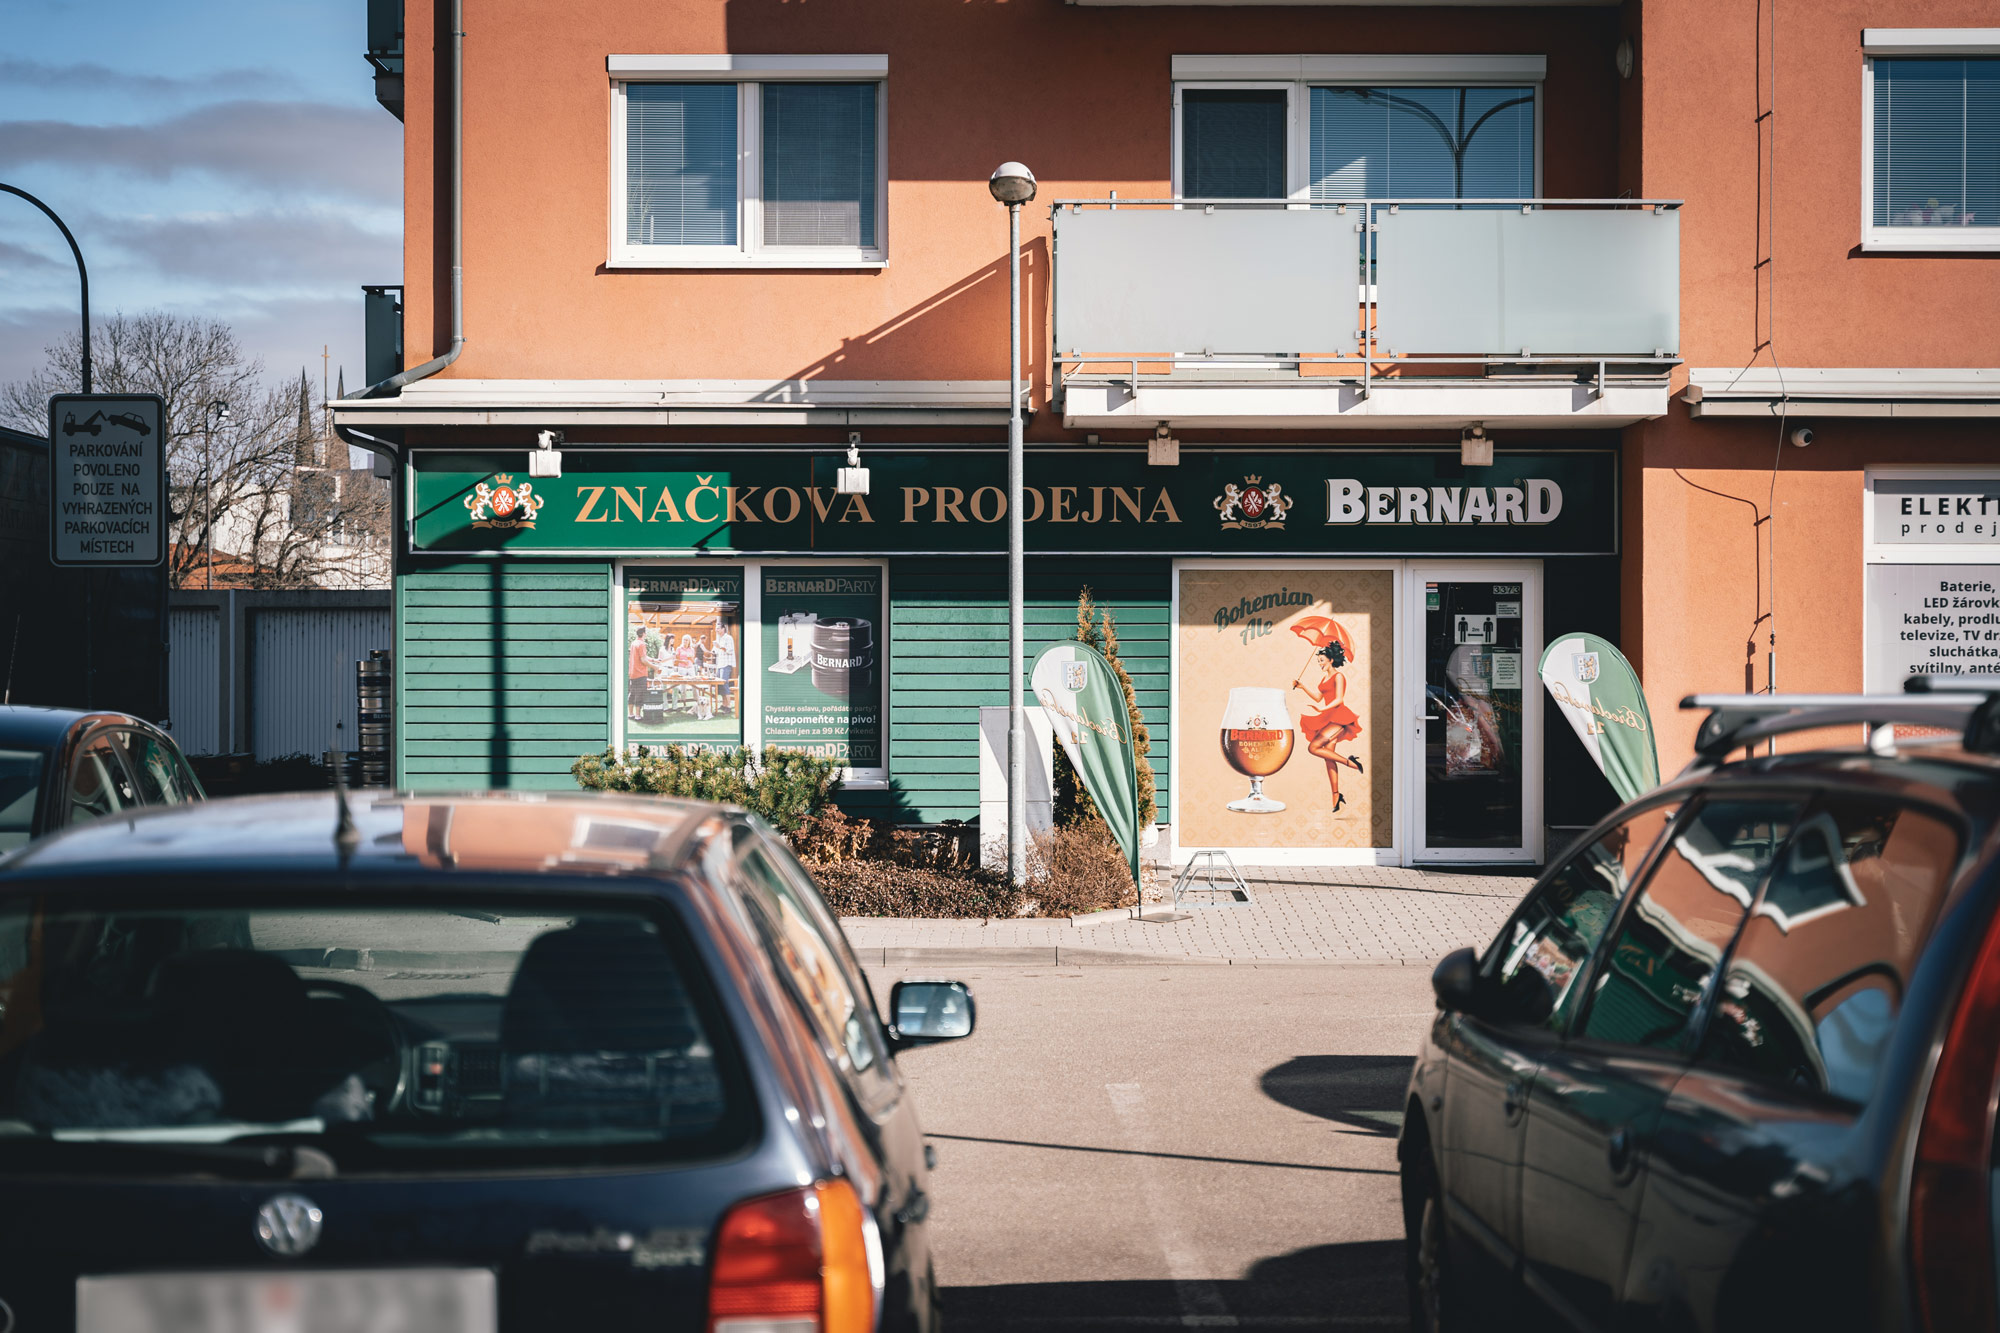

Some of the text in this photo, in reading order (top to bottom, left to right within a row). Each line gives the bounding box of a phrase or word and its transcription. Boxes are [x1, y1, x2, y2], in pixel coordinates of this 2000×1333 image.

[69, 441, 144, 457] PARKOVÁNÍ
[73, 463, 140, 476] POVOLENO
[73, 483, 140, 496] POUZE NA
[62, 499, 152, 515] VYHRAZENÝCH
[900, 486, 1183, 524] PRODEJNA
[1324, 478, 1563, 526] BERNARD
[1901, 497, 2000, 515] ELEKT
[64, 518, 150, 534] PARKOVACÍCH
[1901, 521, 1998, 537] prodej
[80, 537, 134, 553] MÍSTECH
[1494, 586, 1520, 594] 3373
[1940, 581, 1995, 594] Baterie,
[1213, 586, 1314, 633] Bohemian
[1924, 598, 1949, 608] LED
[1904, 613, 1954, 627] kabely,
[1239, 617, 1273, 646] Ale
[1900, 630, 2000, 642] televize, TV dr
[817, 653, 863, 668] BERNARD
[1909, 662, 2000, 675] svítilny, anté
[765, 705, 877, 713] Chystáte oslavu, pořádáte party?
[765, 714, 834, 725] Nezapomeňte
[851, 715, 876, 725] pivo!
[765, 727, 797, 735] Chlazení
[798, 727, 810, 736] jen
[822, 727, 833, 735] 99
[1230, 729, 1284, 741] BERNARD
[628, 742, 739, 757] BRNRDPARTY
[765, 743, 877, 757] NARDPARTY
